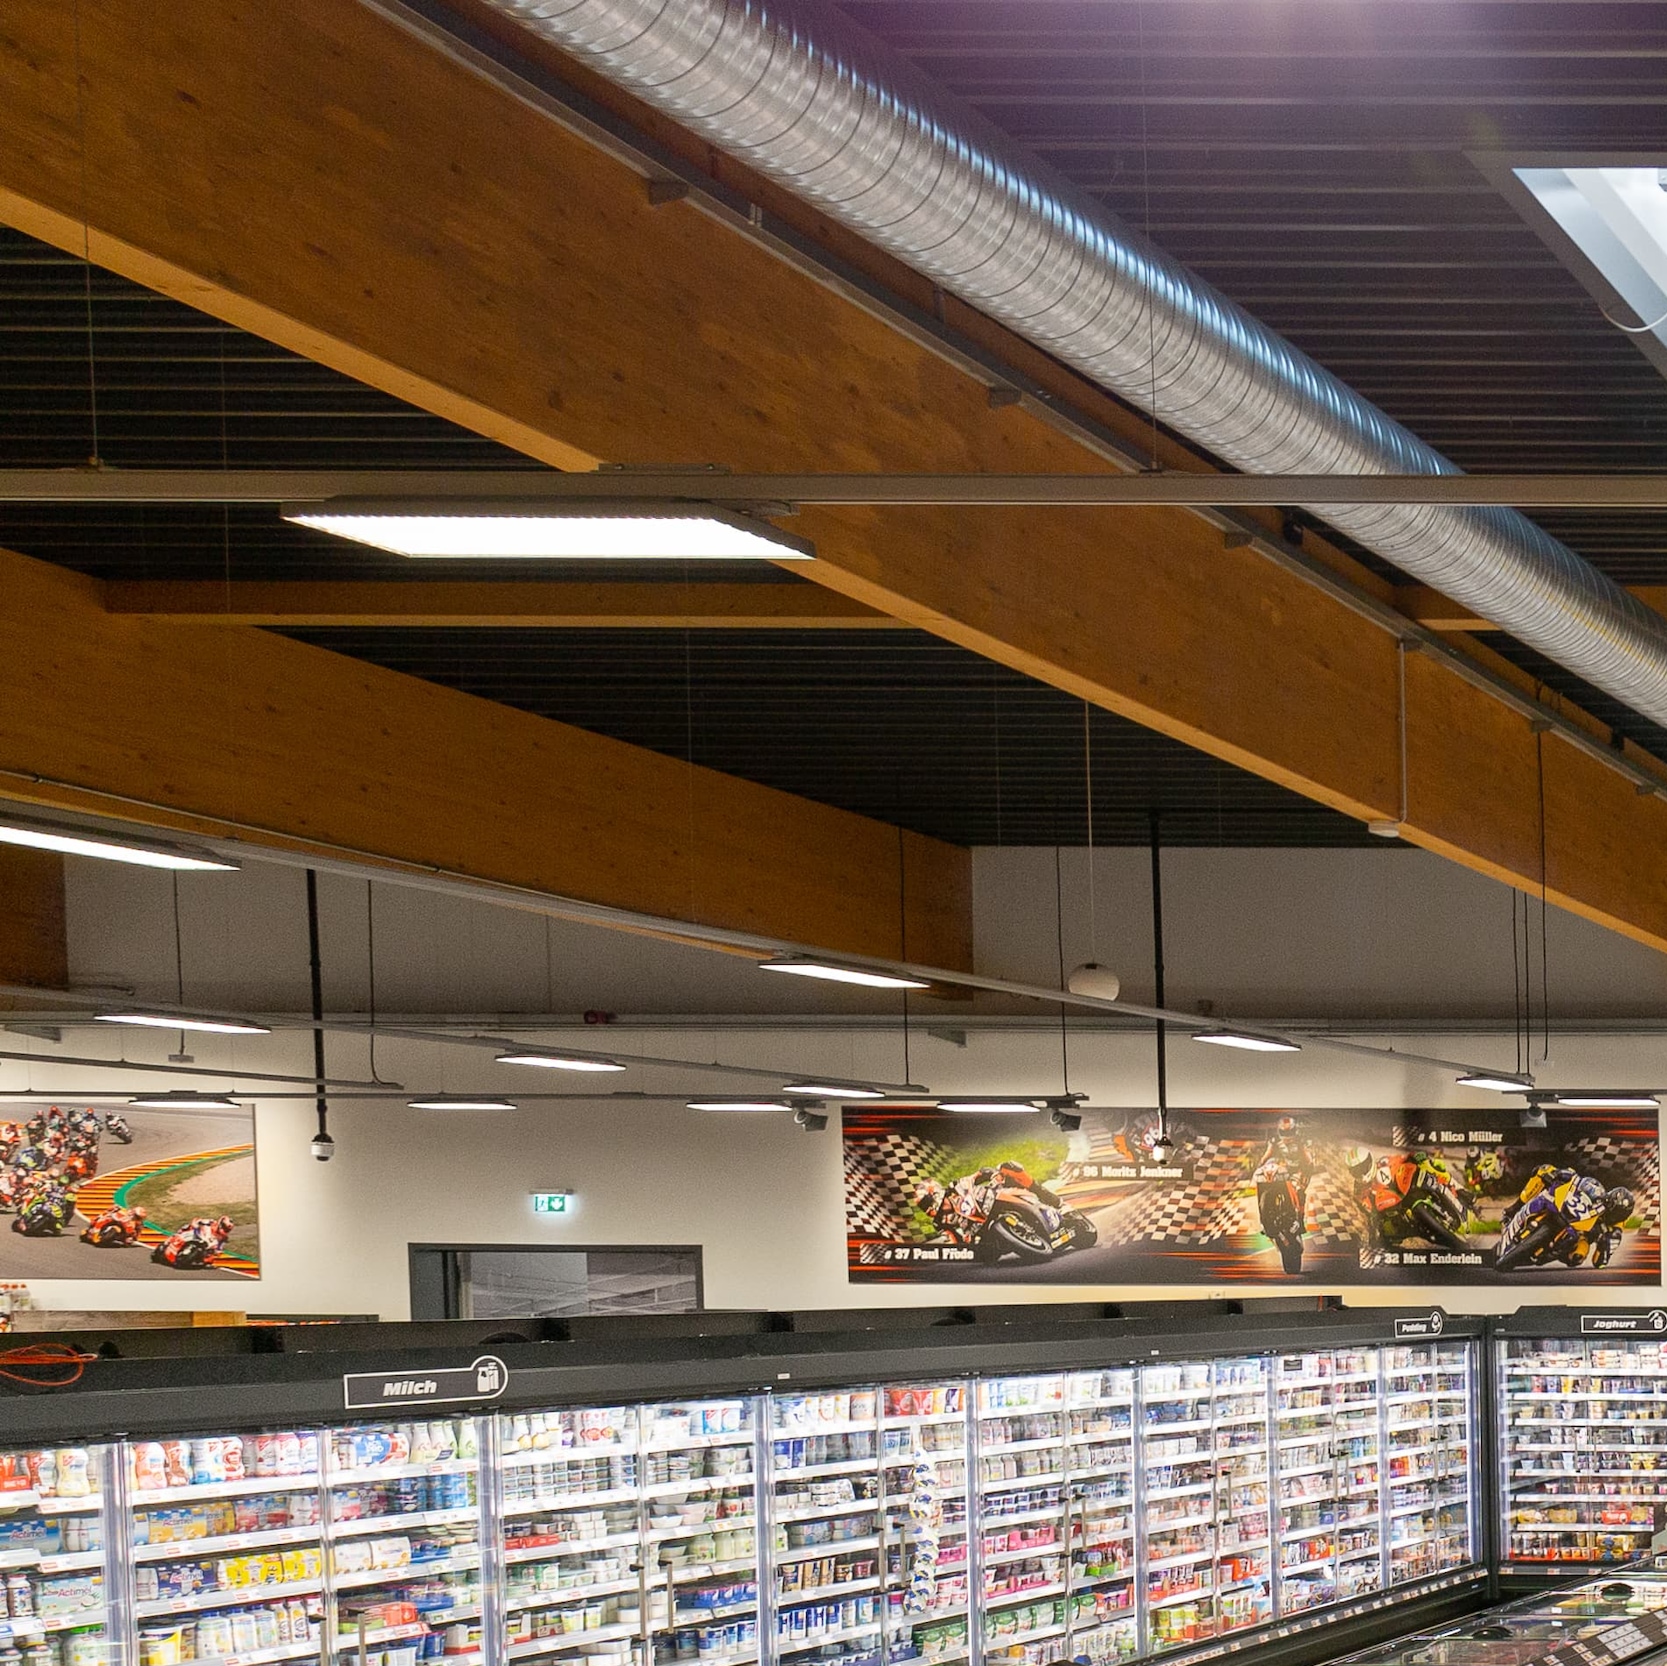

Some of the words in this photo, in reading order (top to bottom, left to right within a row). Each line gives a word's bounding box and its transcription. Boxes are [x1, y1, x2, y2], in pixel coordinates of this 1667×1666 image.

[1429, 1132, 1437, 1142] 4
[1441, 1131, 1465, 1143] Nico
[1469, 1131, 1503, 1143] Müller
[1102, 1166, 1137, 1178] Moritz
[1140, 1165, 1183, 1178] Jenkner
[895, 1249, 909, 1260] 37
[913, 1248, 939, 1260] Paul
[942, 1248, 974, 1260] Fröde
[1384, 1253, 1399, 1264] 32
[1403, 1253, 1427, 1264] Max
[1430, 1253, 1482, 1264] Enderlein
[1593, 1319, 1637, 1331] Joghurt
[383, 1378, 437, 1396] Milch
